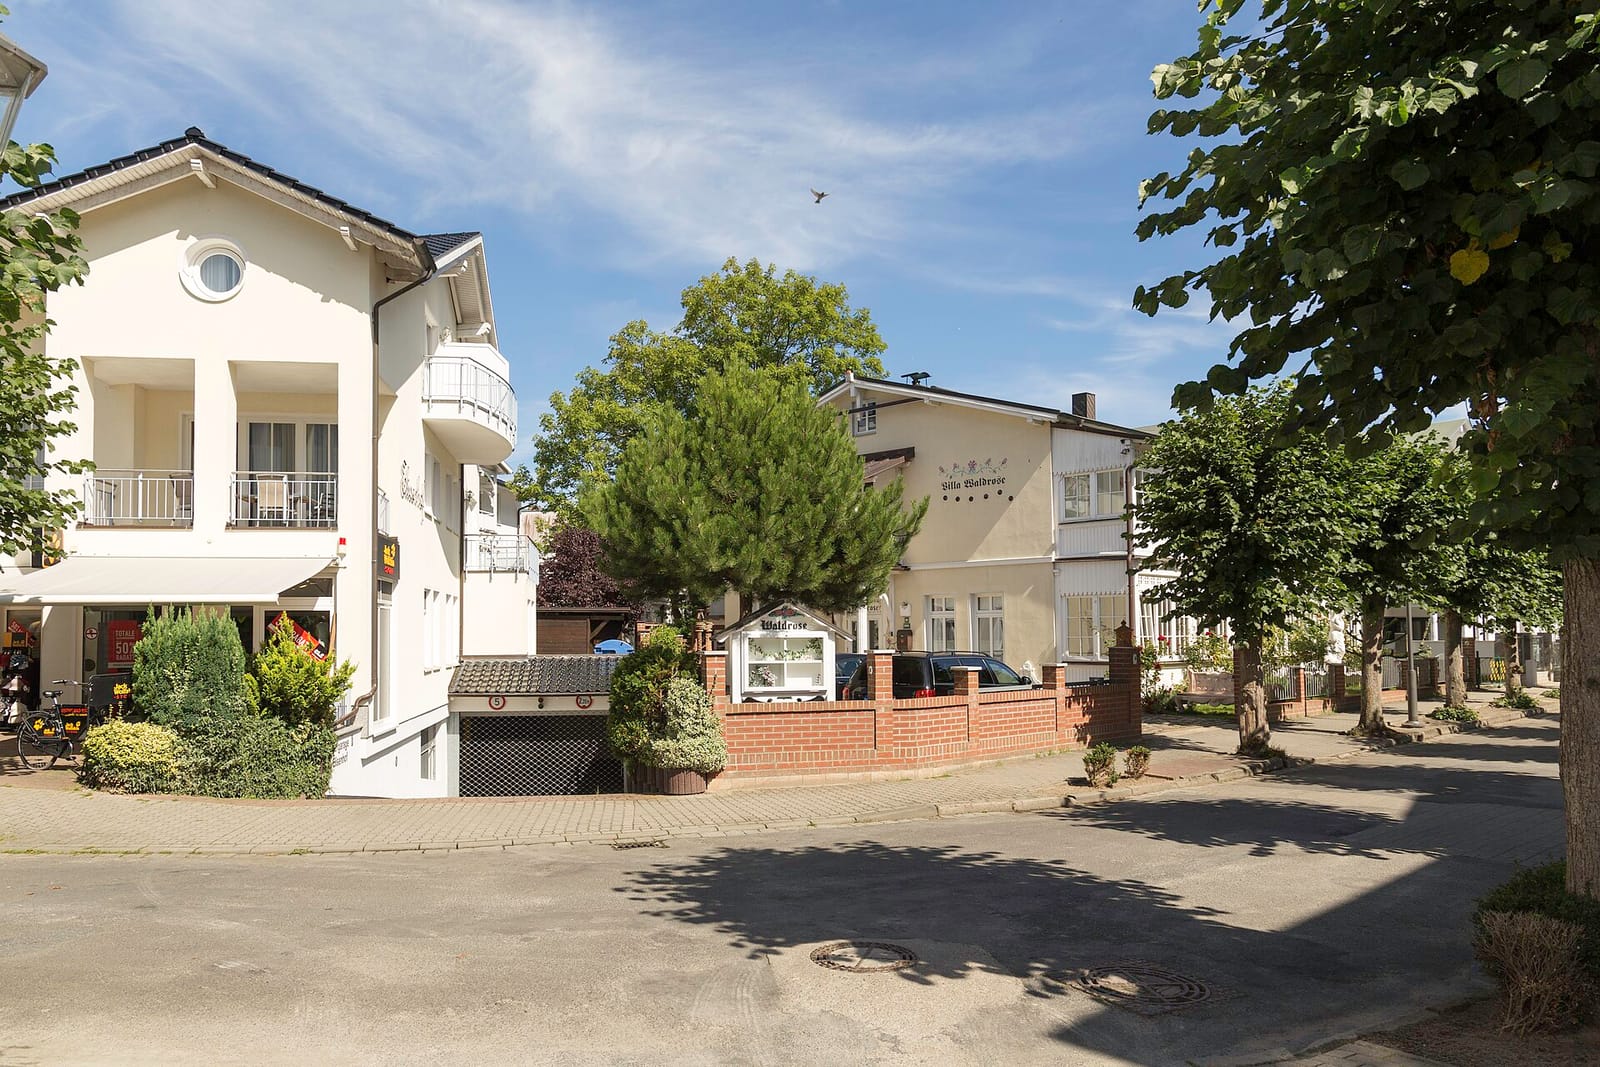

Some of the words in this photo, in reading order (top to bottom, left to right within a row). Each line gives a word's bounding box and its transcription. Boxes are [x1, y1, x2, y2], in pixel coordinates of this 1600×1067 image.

[942, 481, 961, 491] Villa
[963, 477, 1006, 488] Waldrose
[760, 619, 808, 630] Waldrose
[494, 697, 500, 705] 5
